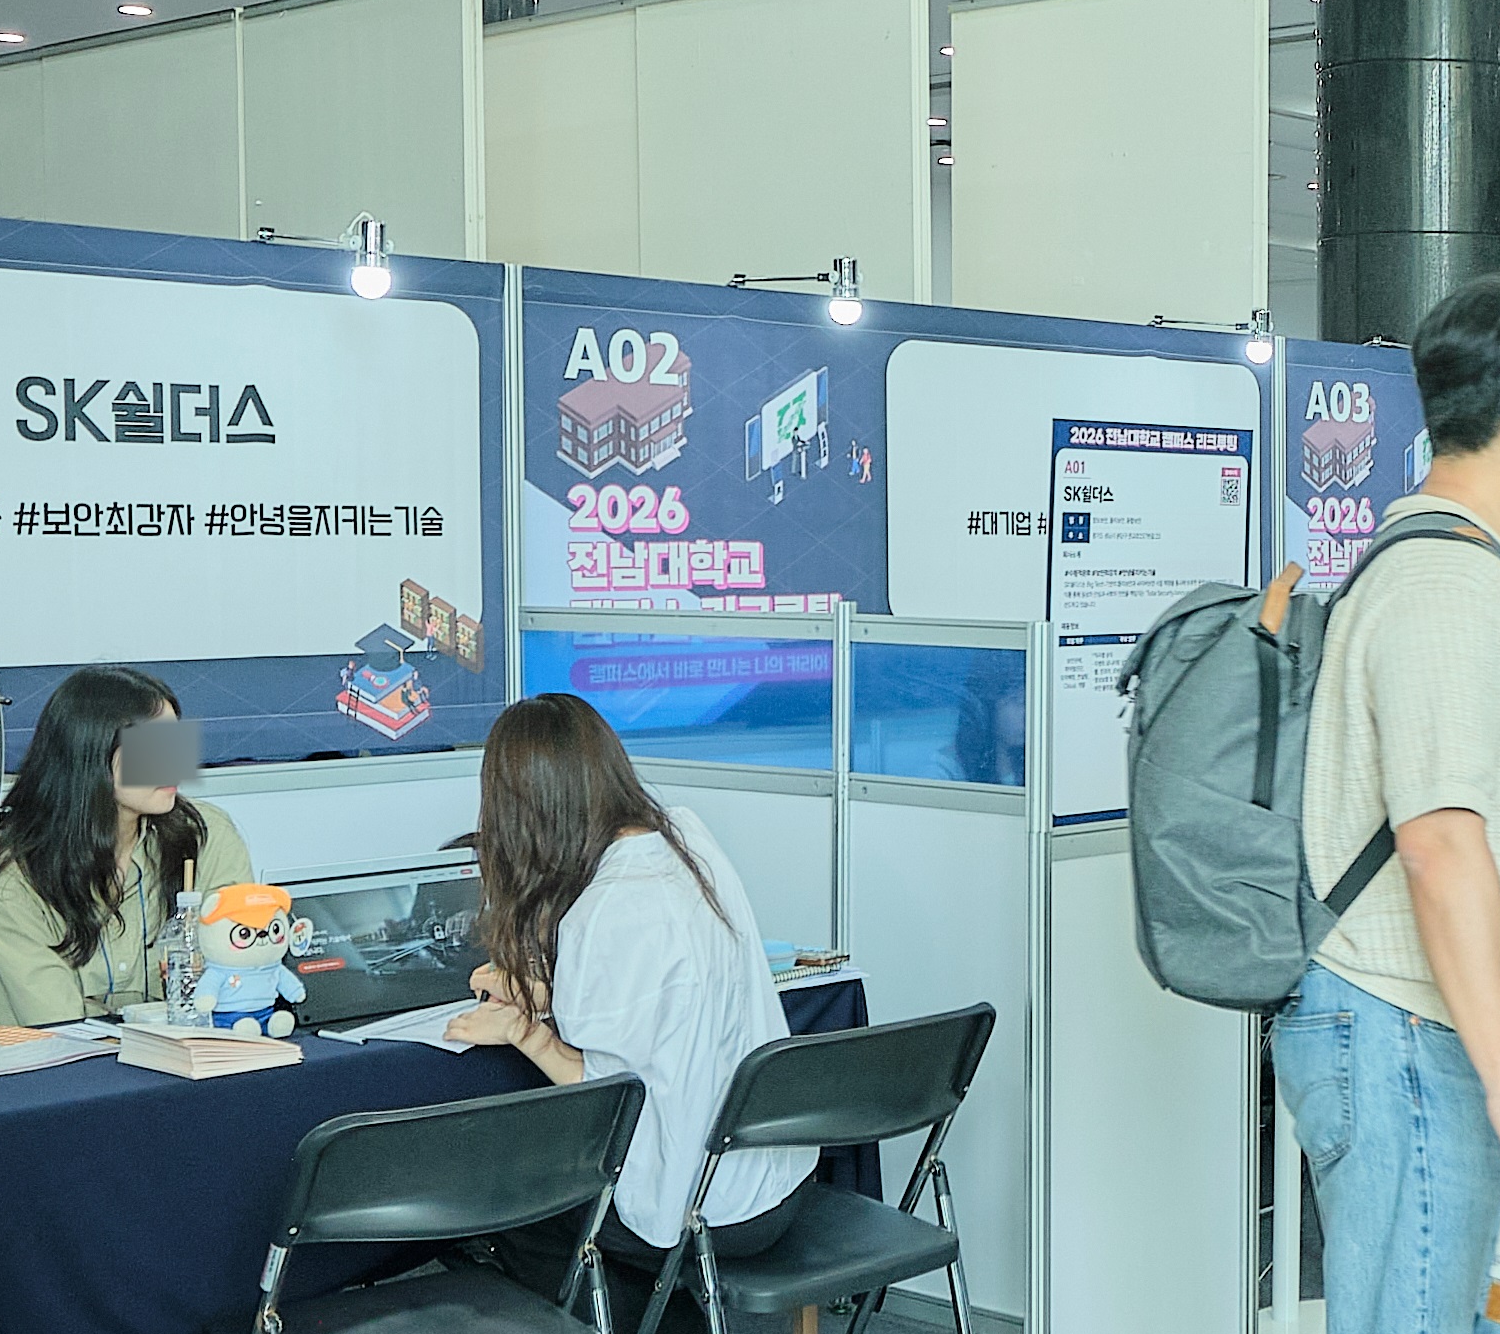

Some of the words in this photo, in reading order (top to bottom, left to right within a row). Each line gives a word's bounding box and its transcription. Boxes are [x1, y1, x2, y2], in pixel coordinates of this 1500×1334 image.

[564, 327, 681, 386] A02
[15, 376, 276, 444] SK쉴더스
[1306, 381, 1371, 423] A03
[1069, 426, 1103, 445] 2026
[1105, 428, 1161, 448] 전남대학교
[1064, 460, 1086, 474] A01
[567, 483, 690, 534] 2026
[1063, 485, 1114, 503] SK쉴더스
[13, 502, 195, 537] #보안최강자
[205, 503, 444, 538] #안녕을지키는기술
[967, 510, 1032, 537] #대기업
[1307, 496, 1375, 534] 2026
[567, 539, 766, 590] 전남대학교
[1306, 538, 1371, 575] 전남대
[673, 656, 703, 679] 바로
[707, 654, 752, 678] 만나는
[754, 652, 784, 676] 나의
